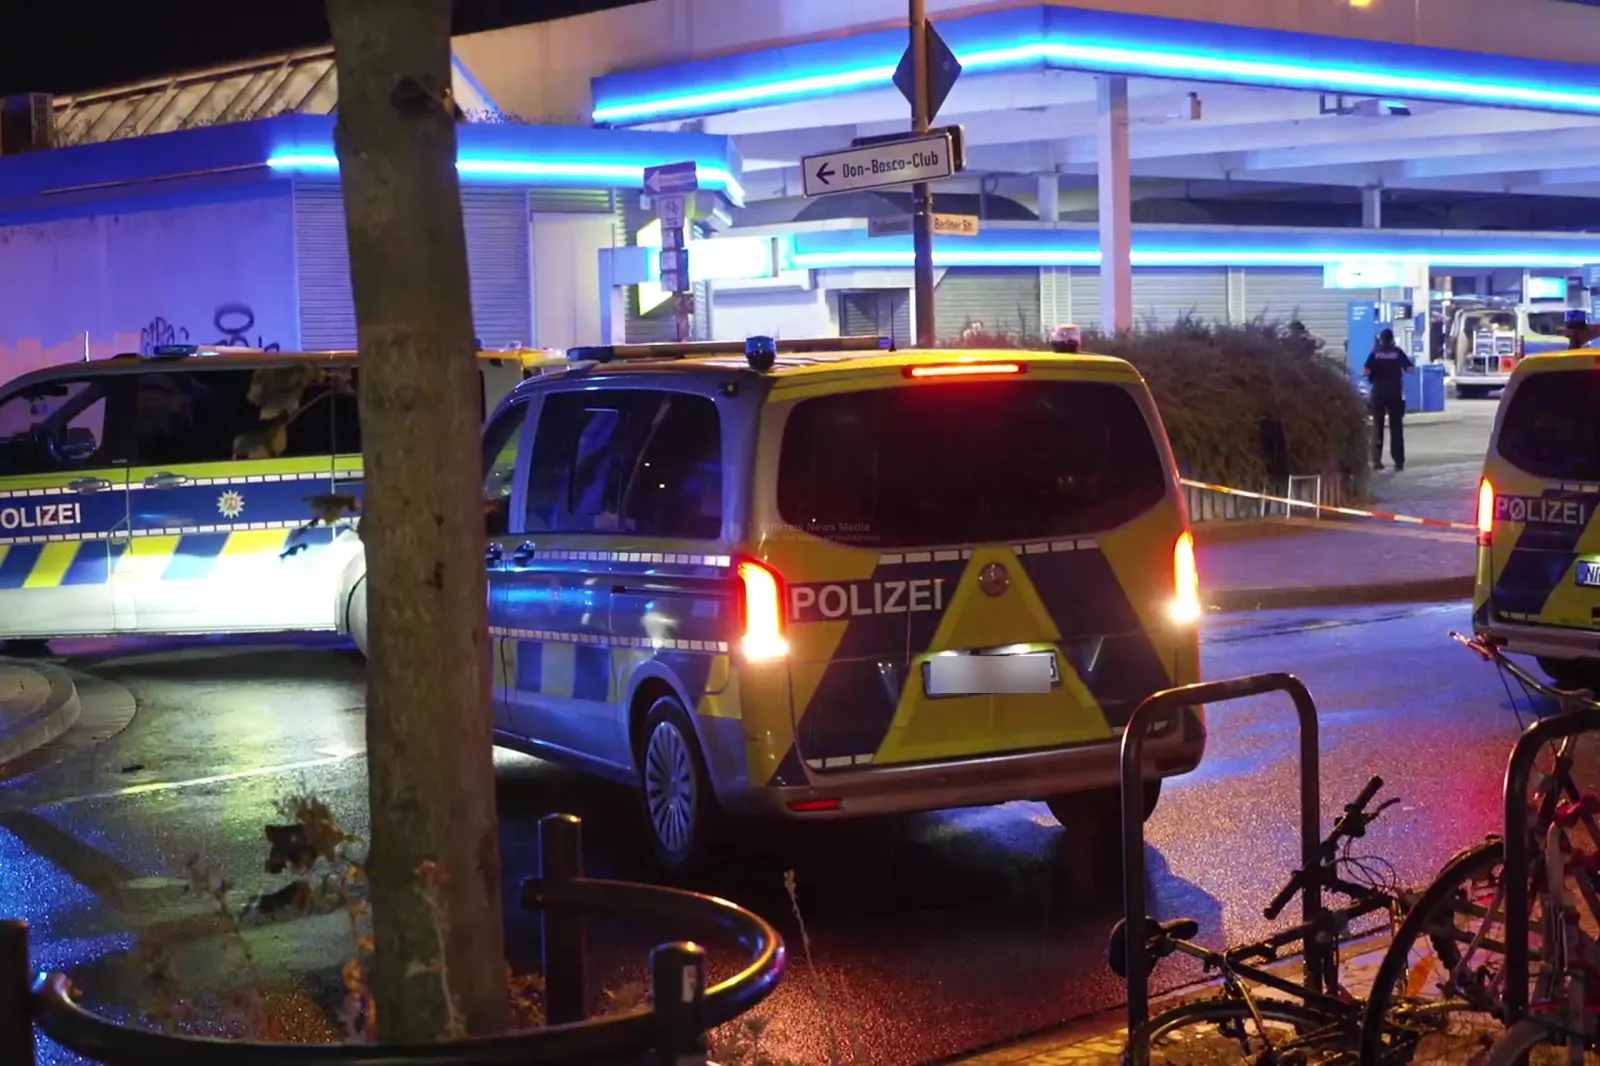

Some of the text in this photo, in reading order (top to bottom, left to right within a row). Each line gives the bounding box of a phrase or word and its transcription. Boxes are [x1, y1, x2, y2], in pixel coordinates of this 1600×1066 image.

[842, 151, 939, 178] Don-Bosco-Club
[0, 503, 81, 529] OLIZEI
[1494, 498, 1585, 524] POLIZEI
[791, 579, 945, 620] POLIZEI
